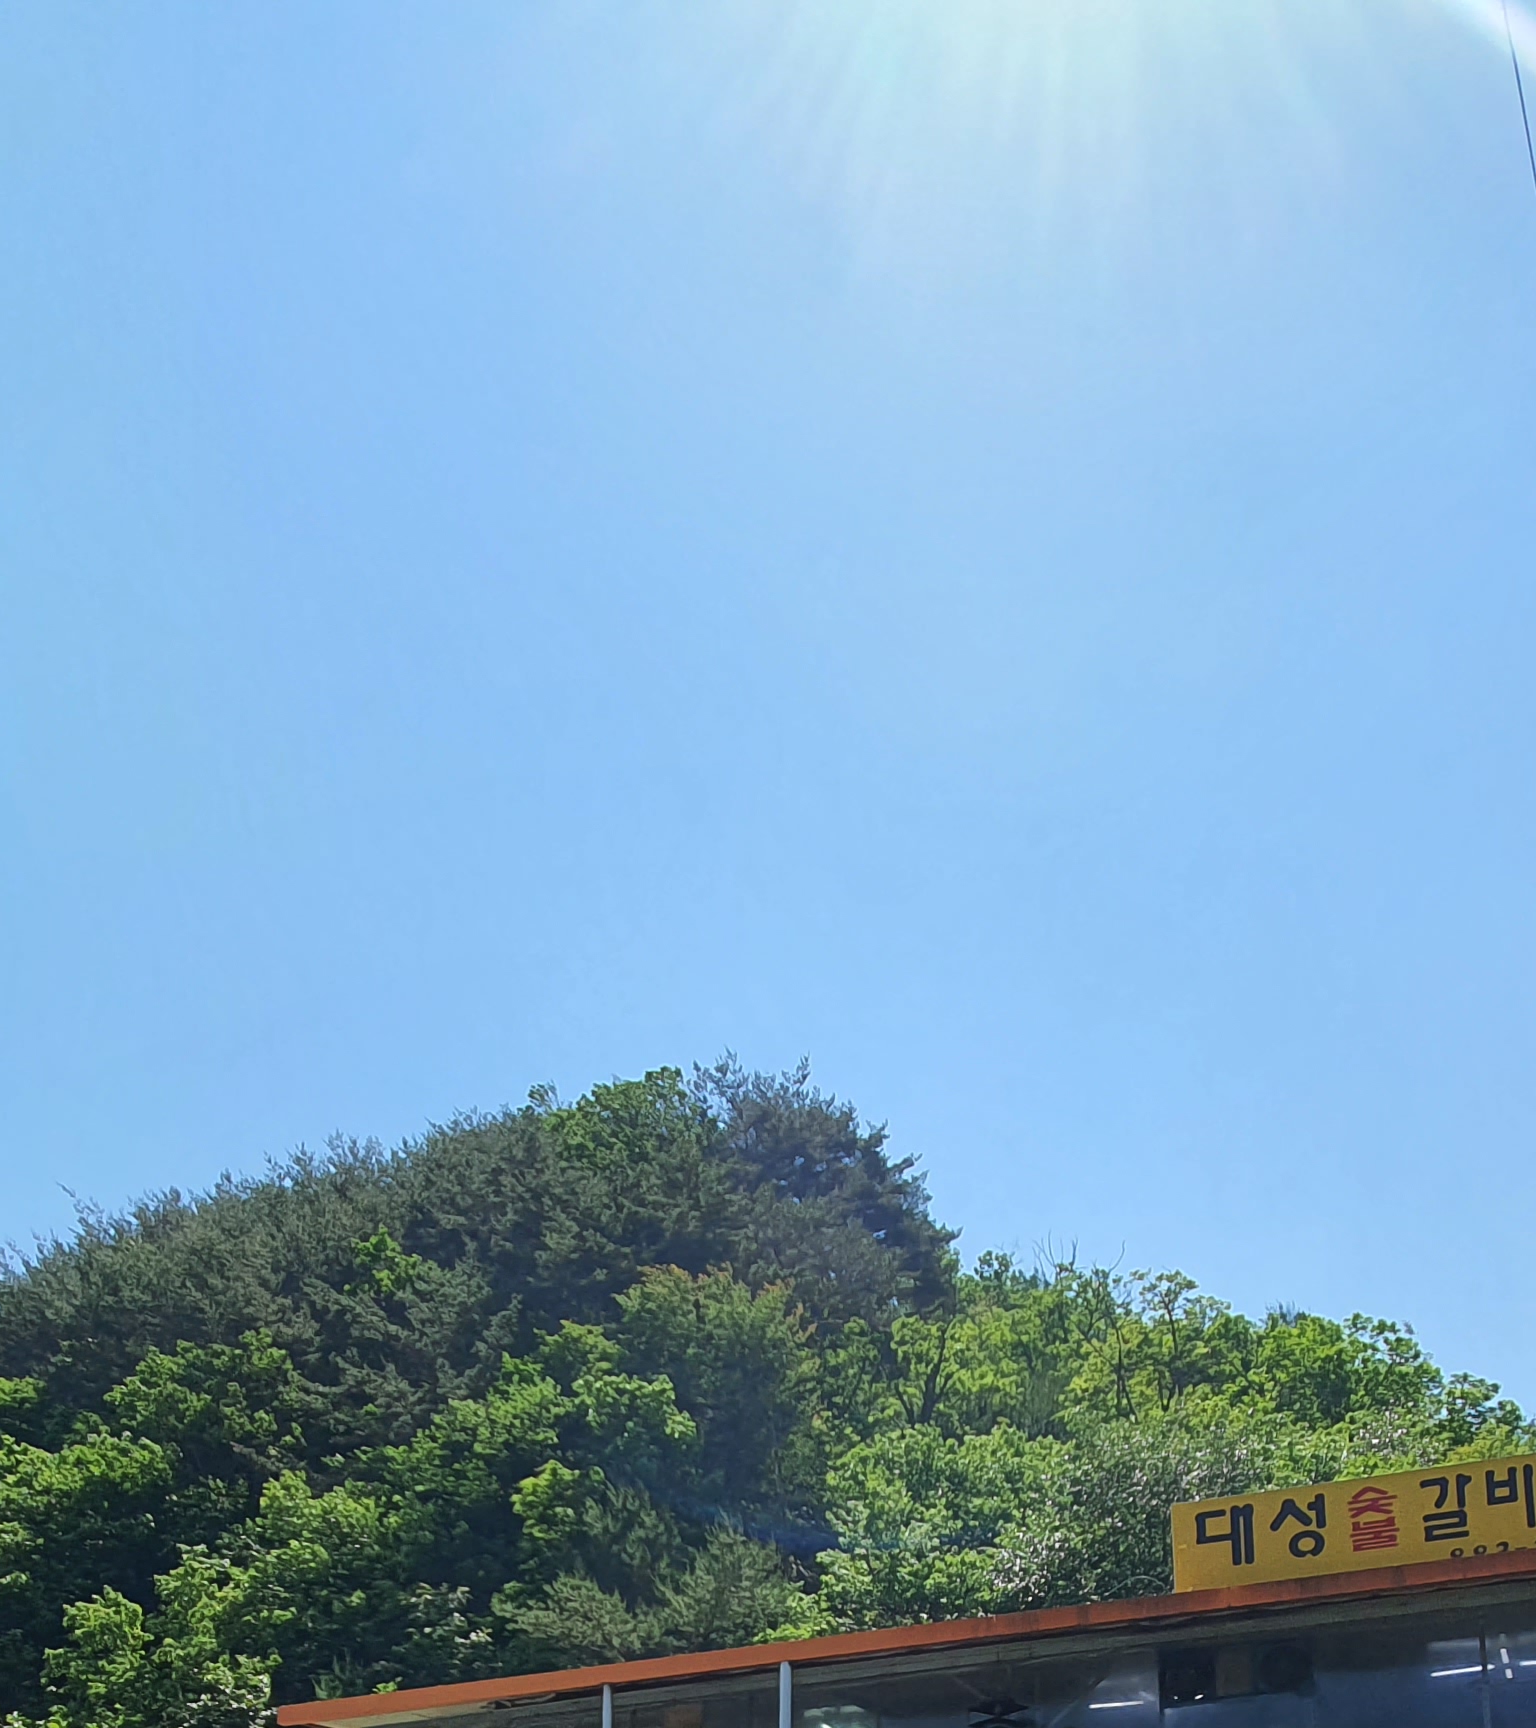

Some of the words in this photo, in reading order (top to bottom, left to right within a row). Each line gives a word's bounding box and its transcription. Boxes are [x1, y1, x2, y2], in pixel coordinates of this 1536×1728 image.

[1195, 1493, 1327, 1566] 대성
[1347, 1485, 1401, 1553] 숯불
[1419, 1463, 1536, 1543] 갈비
